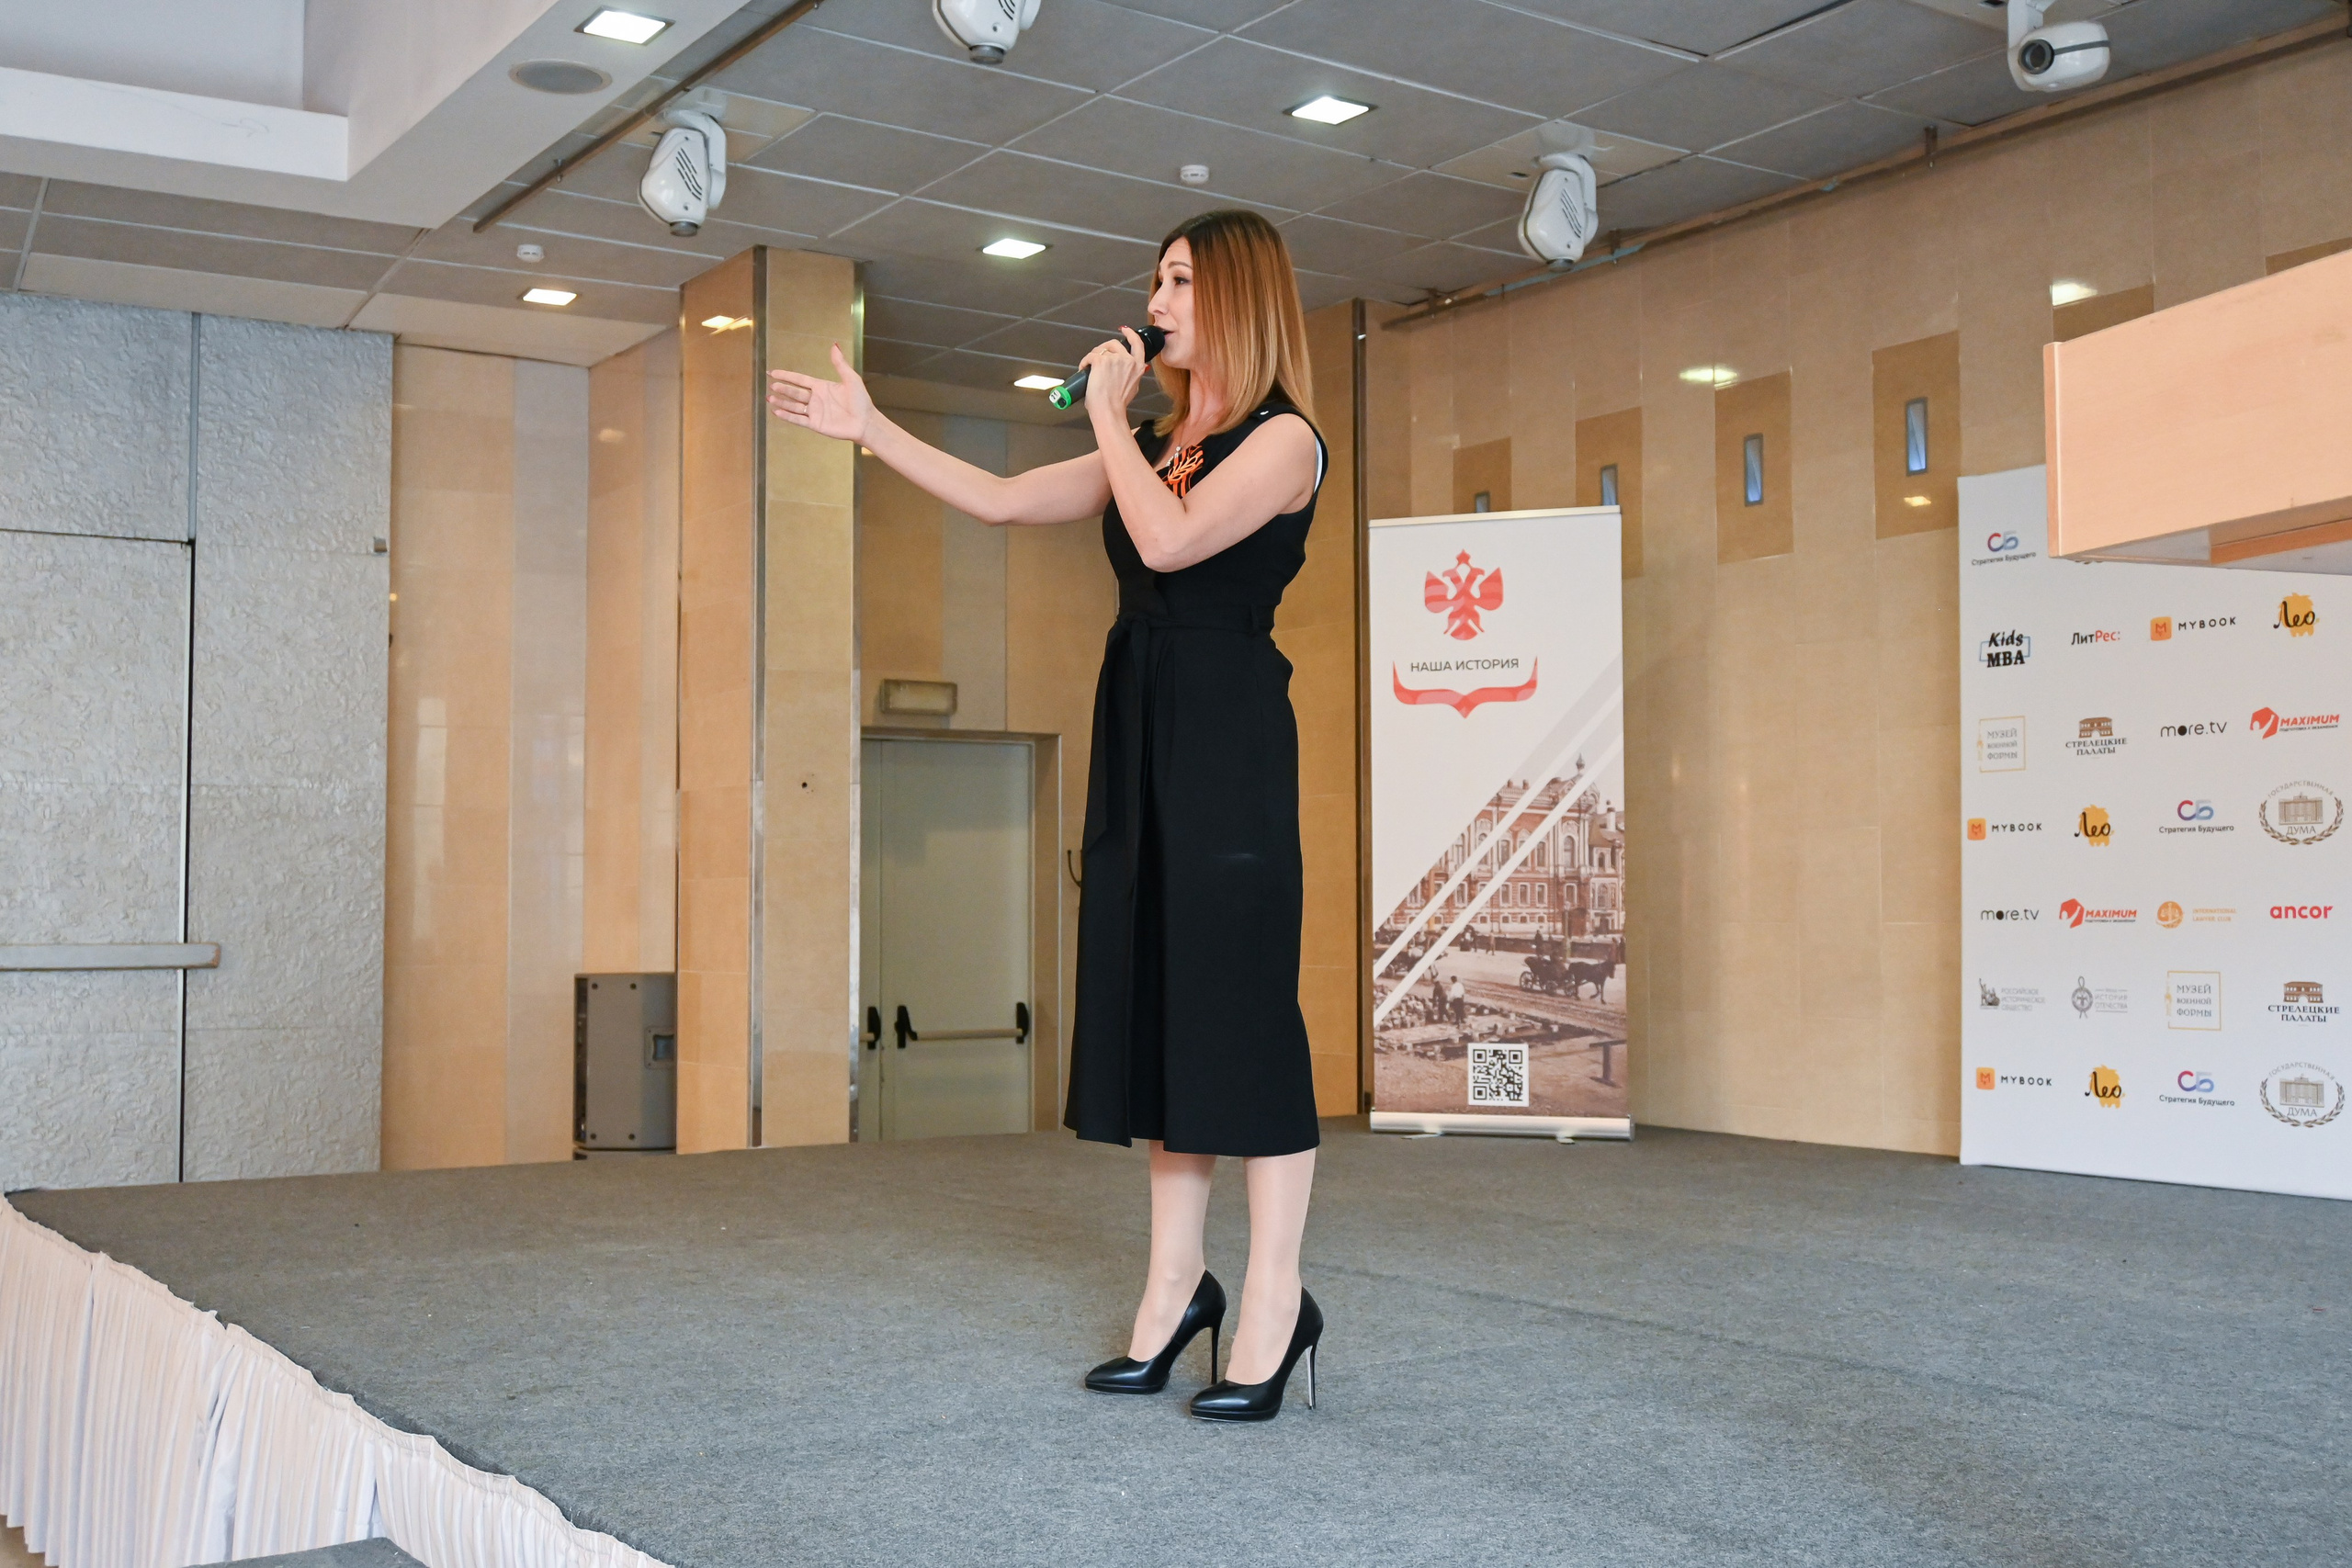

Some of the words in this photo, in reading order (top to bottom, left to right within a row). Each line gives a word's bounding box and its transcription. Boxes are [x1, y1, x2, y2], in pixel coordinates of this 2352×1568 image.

[2273, 600, 2316, 629] Лео
[2178, 616, 2236, 631] MYBOOK
[1988, 629, 2024, 649] Kids
[2071, 630, 2120, 645] ЛитРес:
[1986, 649, 2025, 668] MBA
[1410, 660, 1453, 672] НАША
[1455, 658, 1520, 671] ИСТОРИЯ
[2280, 714, 2339, 726] MAXIMUM
[2065, 738, 2128, 749] СТРЕЛЕЦКИЕ
[2076, 747, 2116, 756] ПАЛАТЫ
[1992, 823, 2042, 832] MYBOOK
[2074, 811, 2111, 837] Лео
[2159, 826, 2196, 834] Стратегия
[2198, 825, 2234, 833] Будущего
[2286, 826, 2316, 837] ДУМА
[2086, 909, 2137, 918] MAXIMUM
[2270, 906, 2334, 919] ancor
[2177, 983, 2211, 994] МУЗЕЙ
[2177, 1008, 2211, 1017] ФОРМЫ
[2268, 1005, 2340, 1014] СТРЕЛЕЦКИЕ
[2281, 1014, 2326, 1022] ПАЛАТЫ
[2001, 1076, 2052, 1086] MYBOOK
[2085, 1071, 2121, 1098] Лео
[2159, 1095, 2197, 1104] Стратегия
[2199, 1097, 2235, 1106] Будущего
[2287, 1108, 2317, 1117] ДУМА
